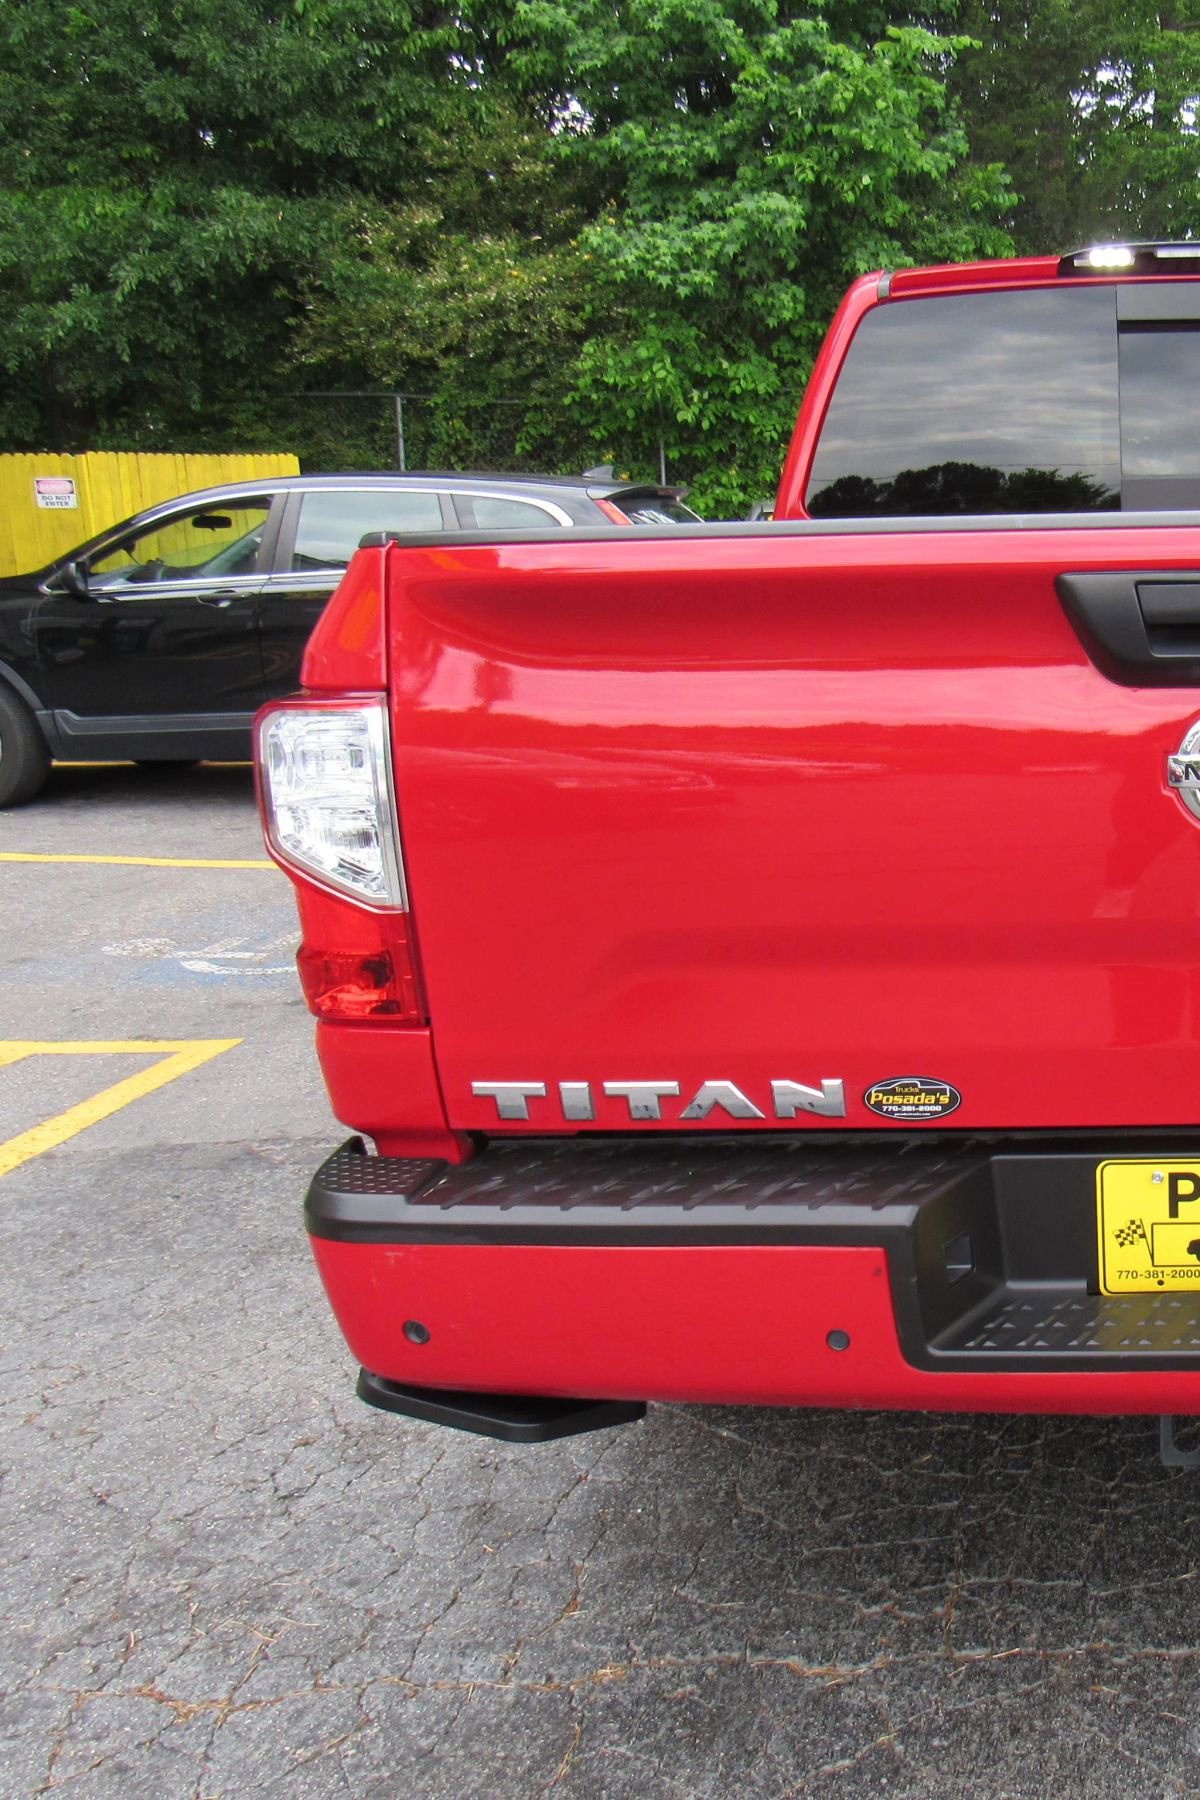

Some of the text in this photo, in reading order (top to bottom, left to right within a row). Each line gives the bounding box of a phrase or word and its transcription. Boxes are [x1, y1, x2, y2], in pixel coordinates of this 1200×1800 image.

[470, 1078, 847, 1121] TITAN
[869, 1092, 950, 1105] Posada's
[1116, 1269, 1200, 1279] 770-381-2000
